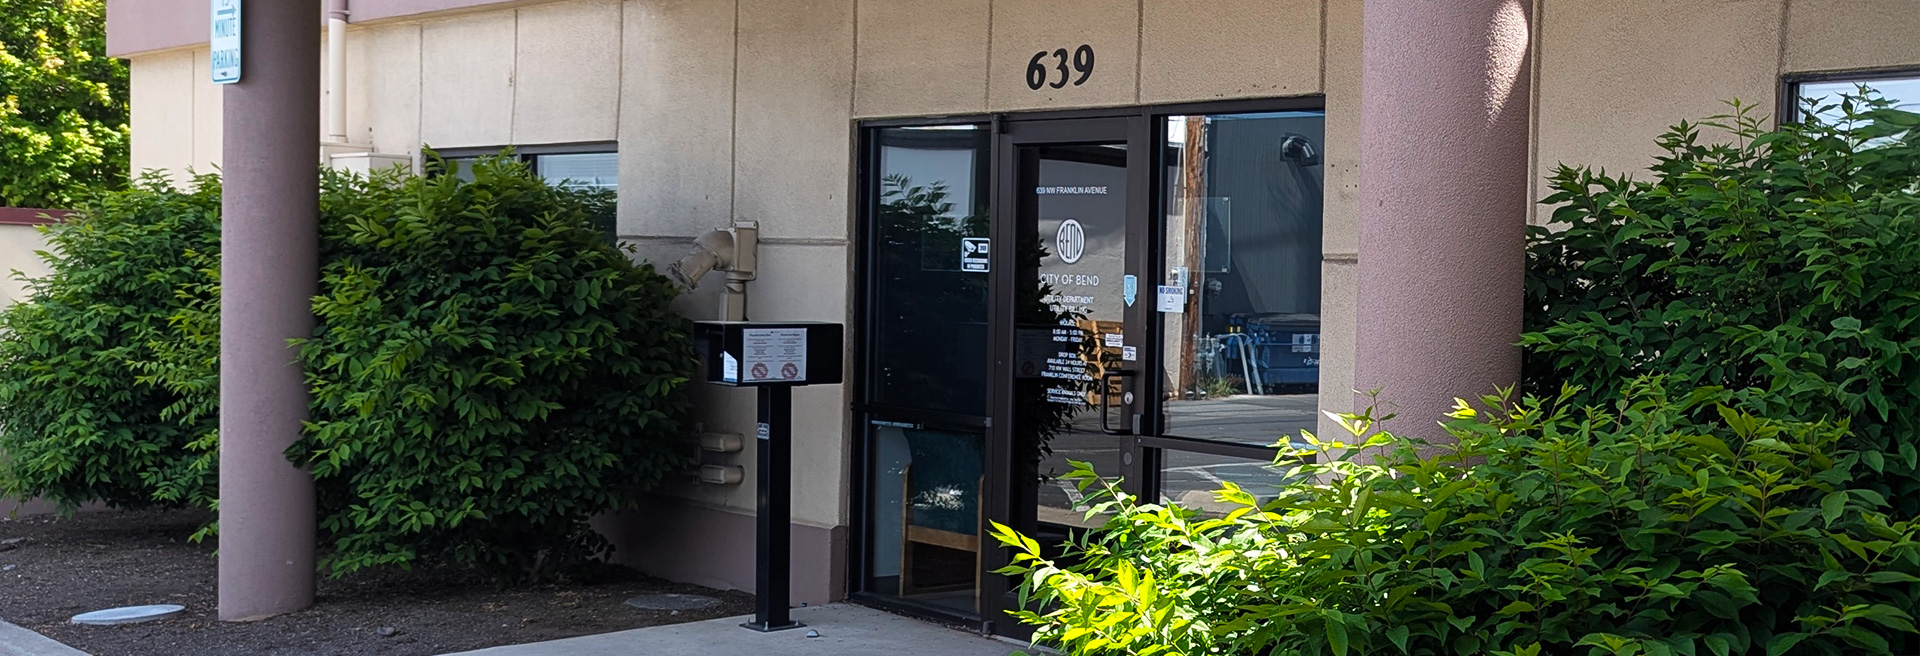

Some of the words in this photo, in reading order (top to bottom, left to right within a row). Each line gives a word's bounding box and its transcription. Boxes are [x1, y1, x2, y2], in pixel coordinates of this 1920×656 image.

[215, 17, 236, 38] MINUTE
[213, 48, 239, 70] PARKING
[1026, 44, 1095, 90] 639
[1046, 186, 1056, 194] NW
[1056, 186, 1084, 195] FRANKLIN
[1084, 186, 1108, 195] AVENUE
[1058, 222, 1083, 260] BEND
[1040, 273, 1060, 285] CITY
[1061, 274, 1074, 285] OF
[1075, 274, 1100, 286] BEND
[1159, 286, 1166, 294] NO
[1166, 286, 1184, 295] SMOKING
[1062, 295, 1094, 304] DEPARTMENT
